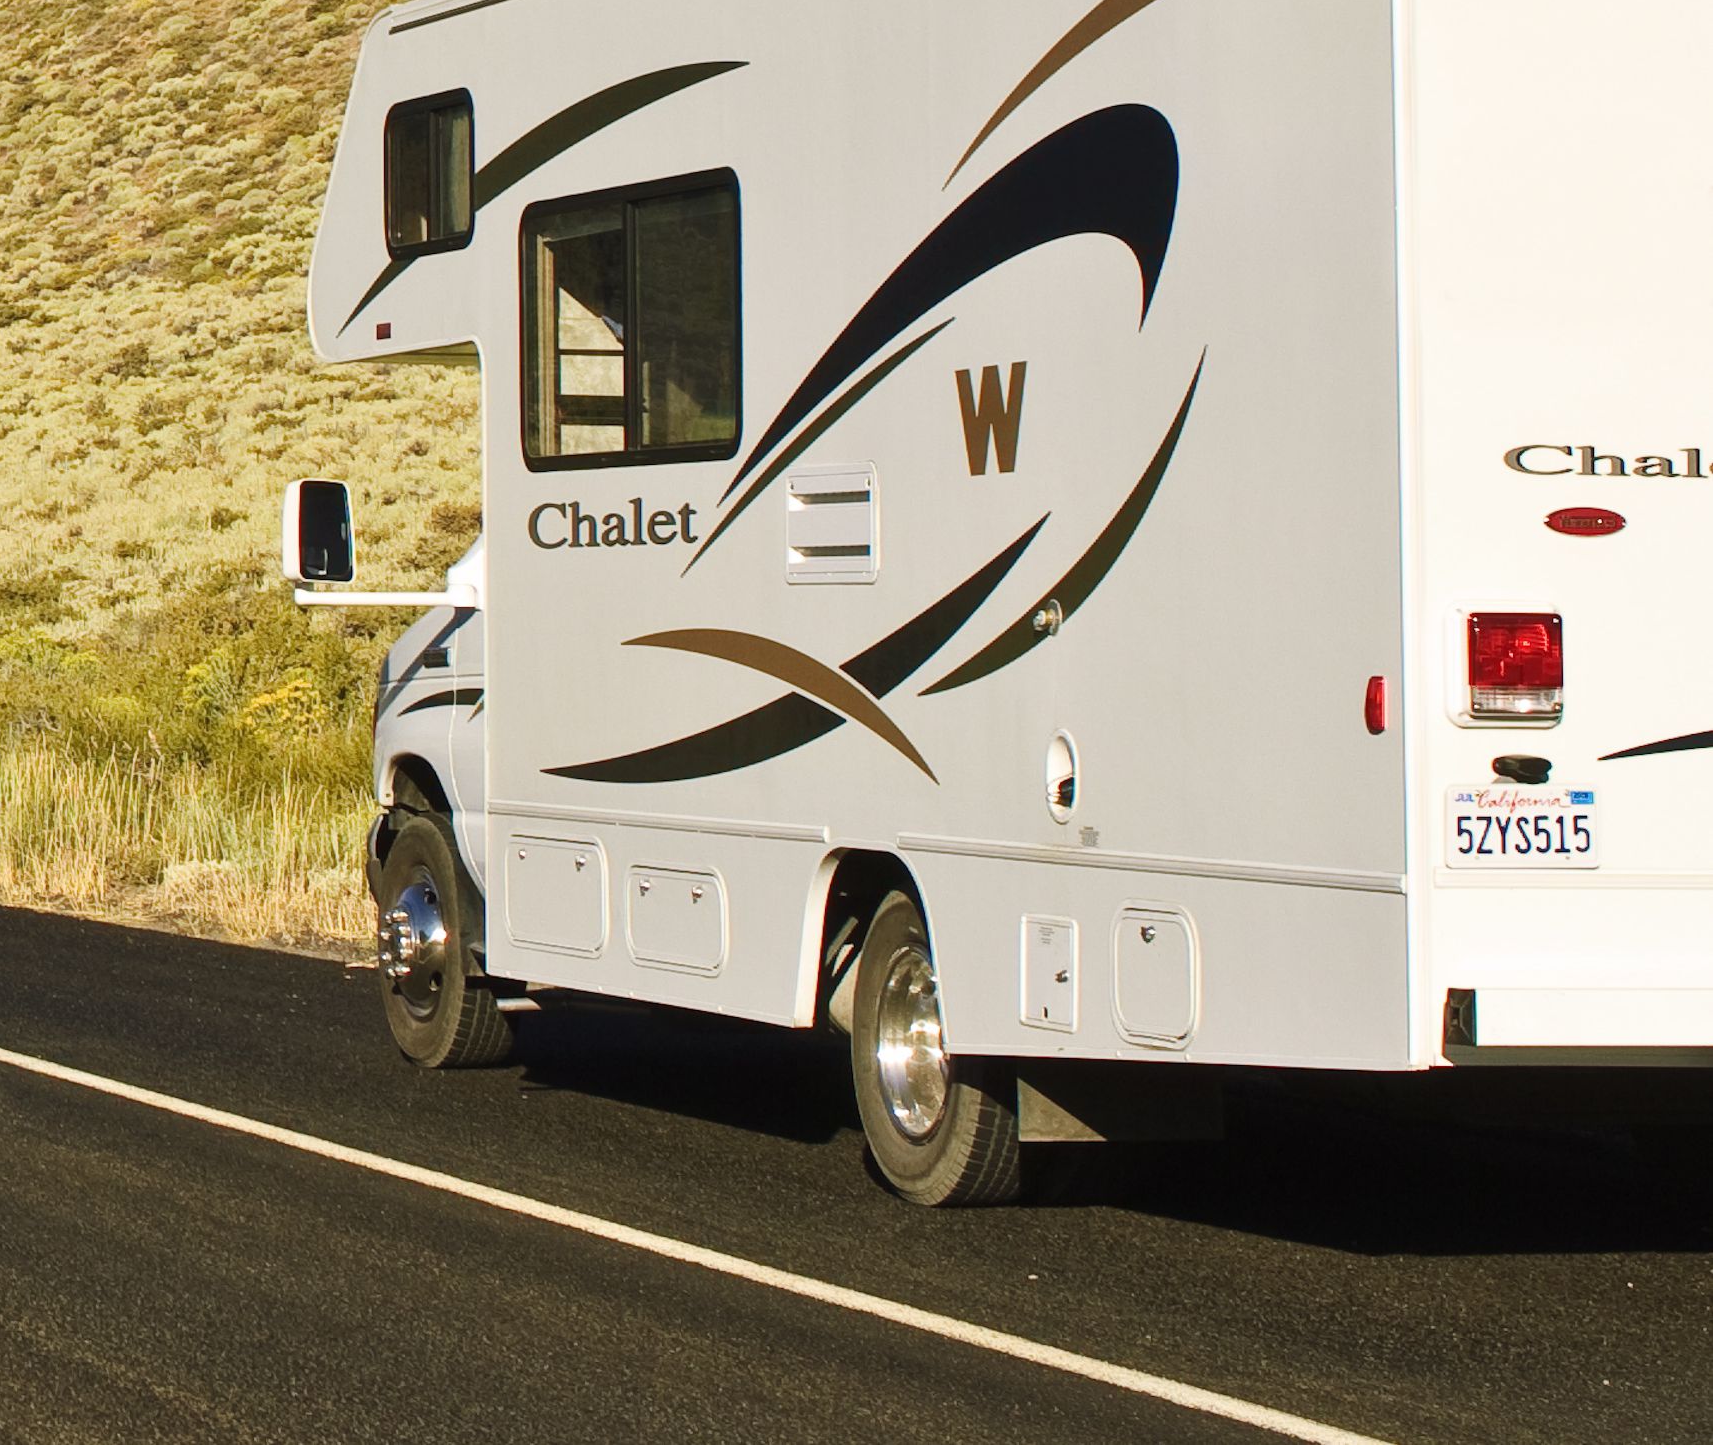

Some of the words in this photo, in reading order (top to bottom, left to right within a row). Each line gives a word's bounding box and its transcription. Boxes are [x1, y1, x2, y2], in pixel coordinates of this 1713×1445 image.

[955, 360, 1028, 476] W
[1503, 444, 1713, 478] Chal
[528, 497, 699, 550] Chalet
[1477, 789, 1571, 813] California
[1457, 815, 1591, 854] 5ZYS515
